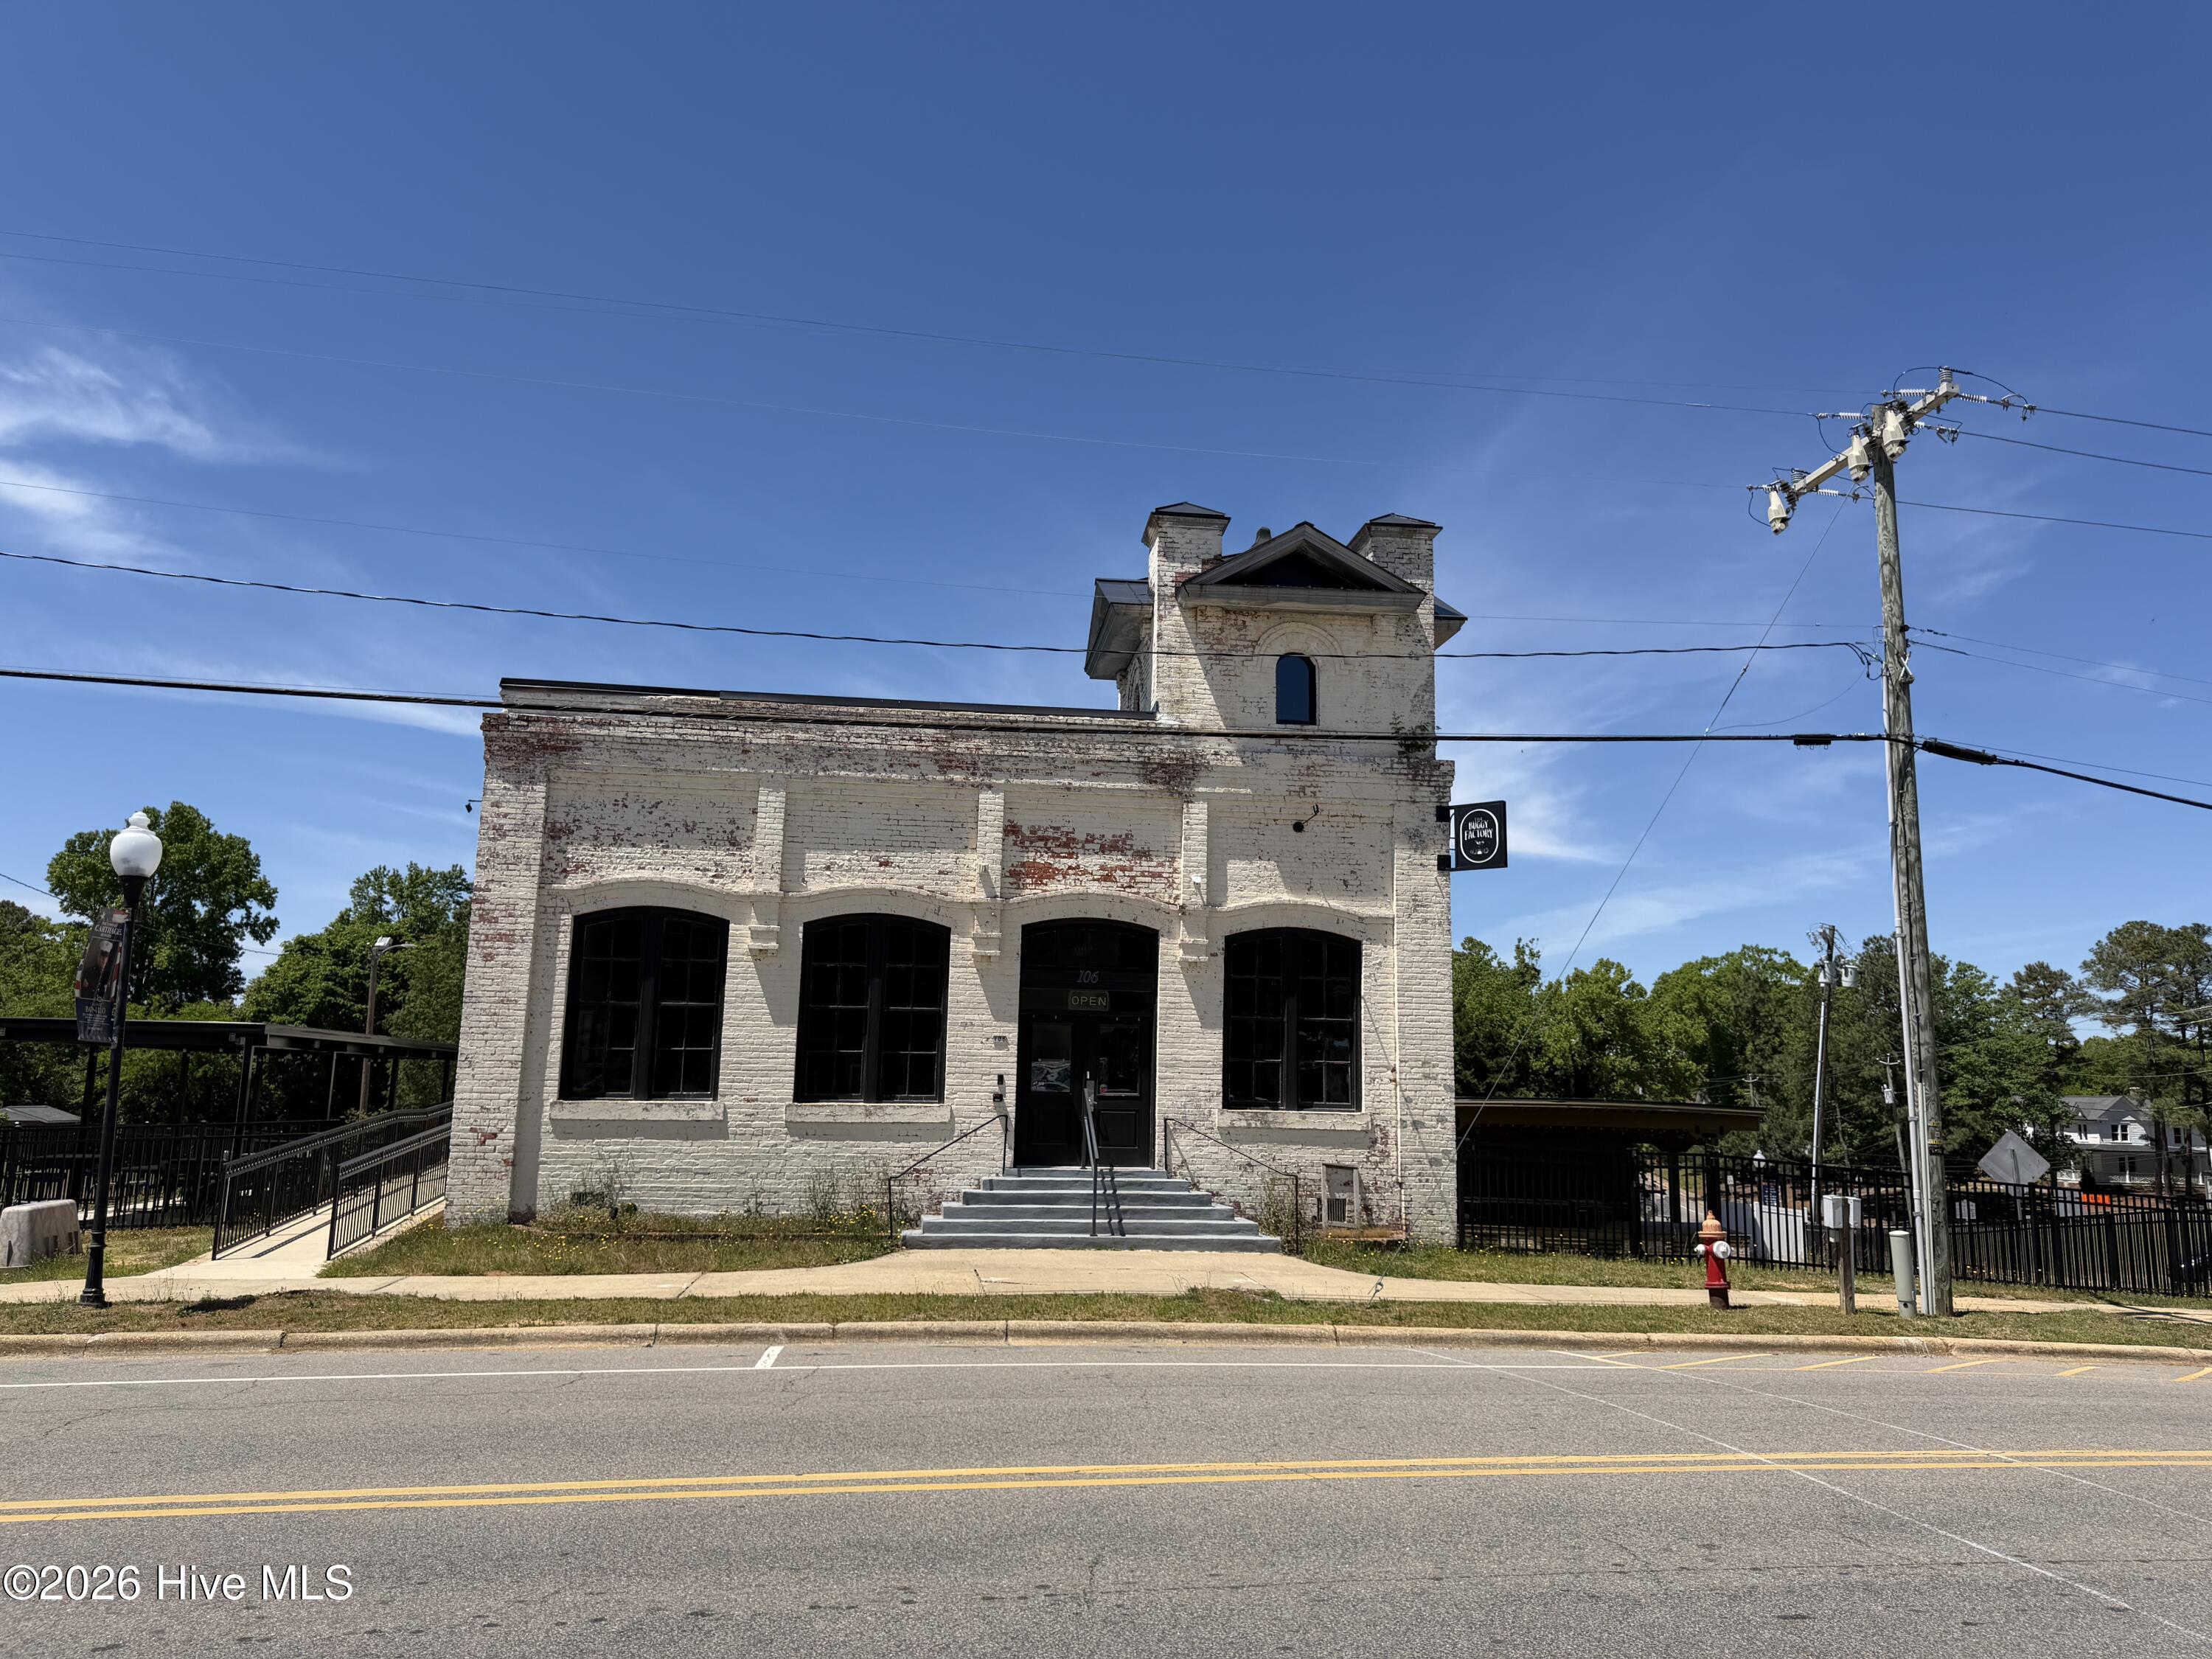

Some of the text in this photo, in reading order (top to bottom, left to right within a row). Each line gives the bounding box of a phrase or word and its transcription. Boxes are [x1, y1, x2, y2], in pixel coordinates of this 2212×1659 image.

[1468, 820, 1489, 830] BUGGY
[1464, 828, 1493, 841] FACTORY
[1077, 970, 1099, 984] 106
[1071, 996, 1106, 1006] OPEN
